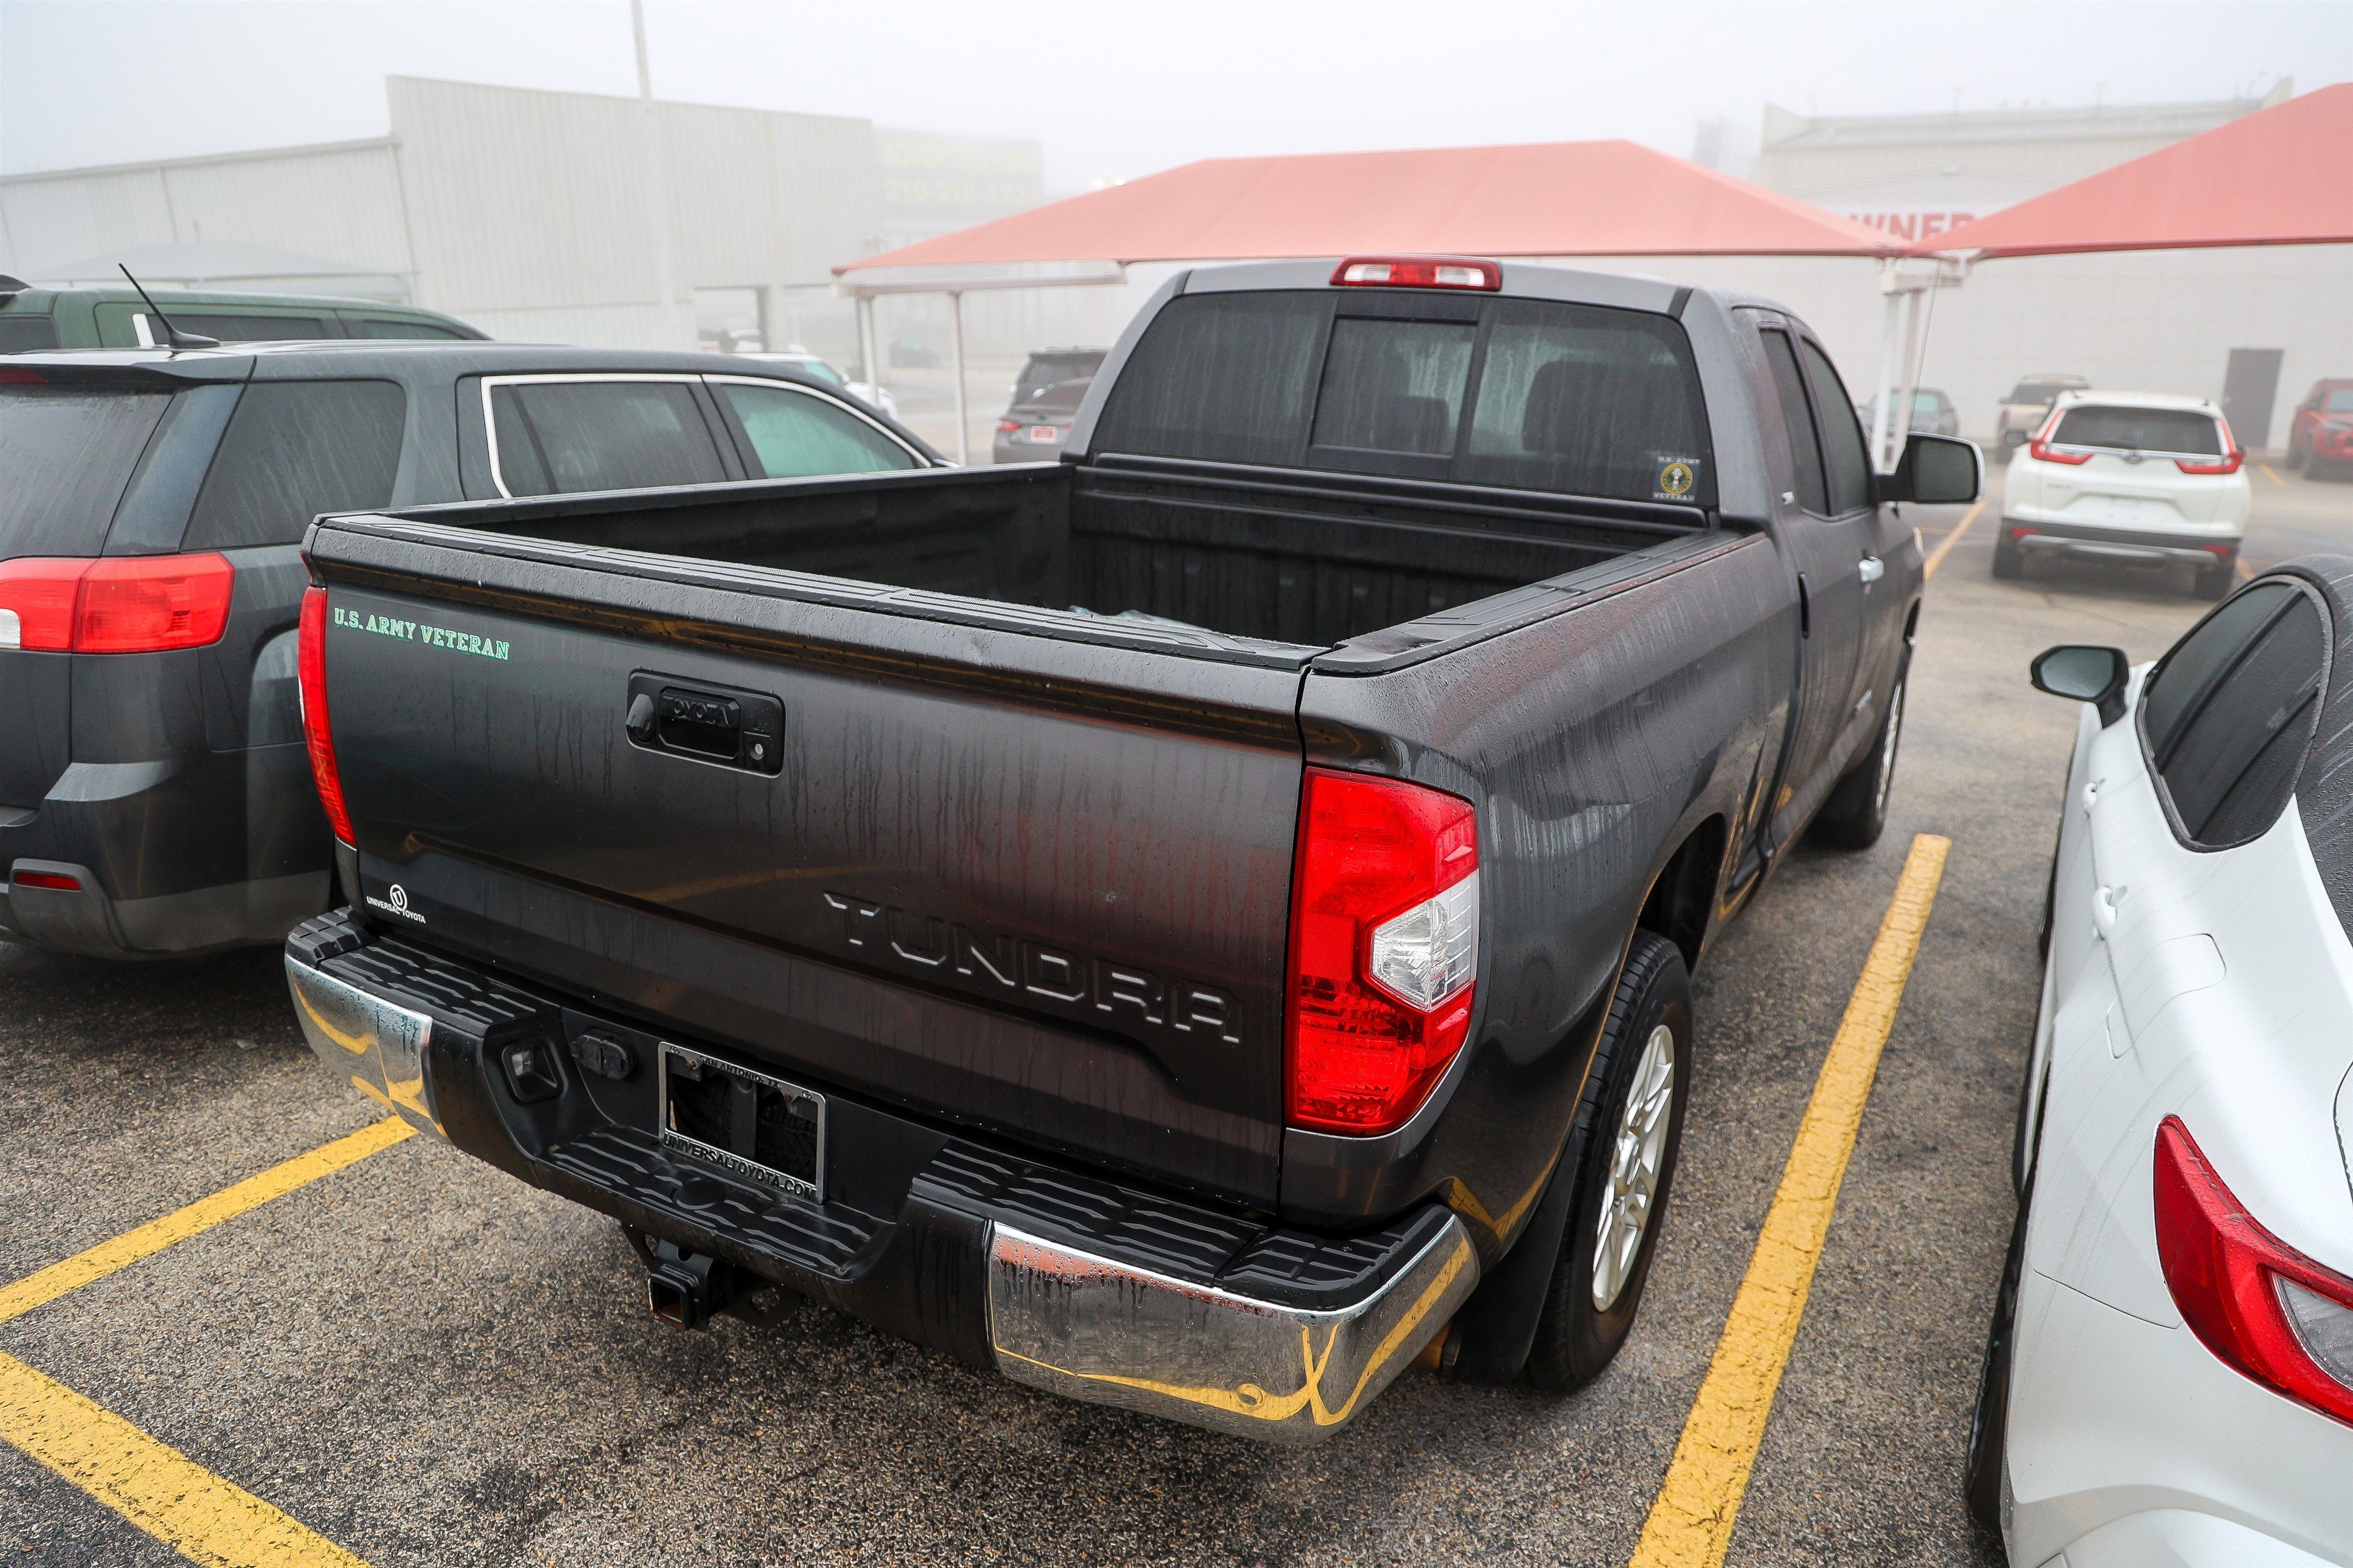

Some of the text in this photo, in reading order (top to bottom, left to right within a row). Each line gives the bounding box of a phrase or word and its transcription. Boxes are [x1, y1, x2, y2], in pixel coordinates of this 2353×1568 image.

[334, 607, 510, 661] U.S. ARMY VETERAN
[663, 696, 731, 727] TOYOTA
[366, 896, 426, 924] UNIVERSAL TOYOTA
[822, 890, 1241, 1044] TUNDRA
[699, 1055, 718, 1068] SAN
[663, 1131, 819, 1200] UNIVERSALTOYOTA.COM
